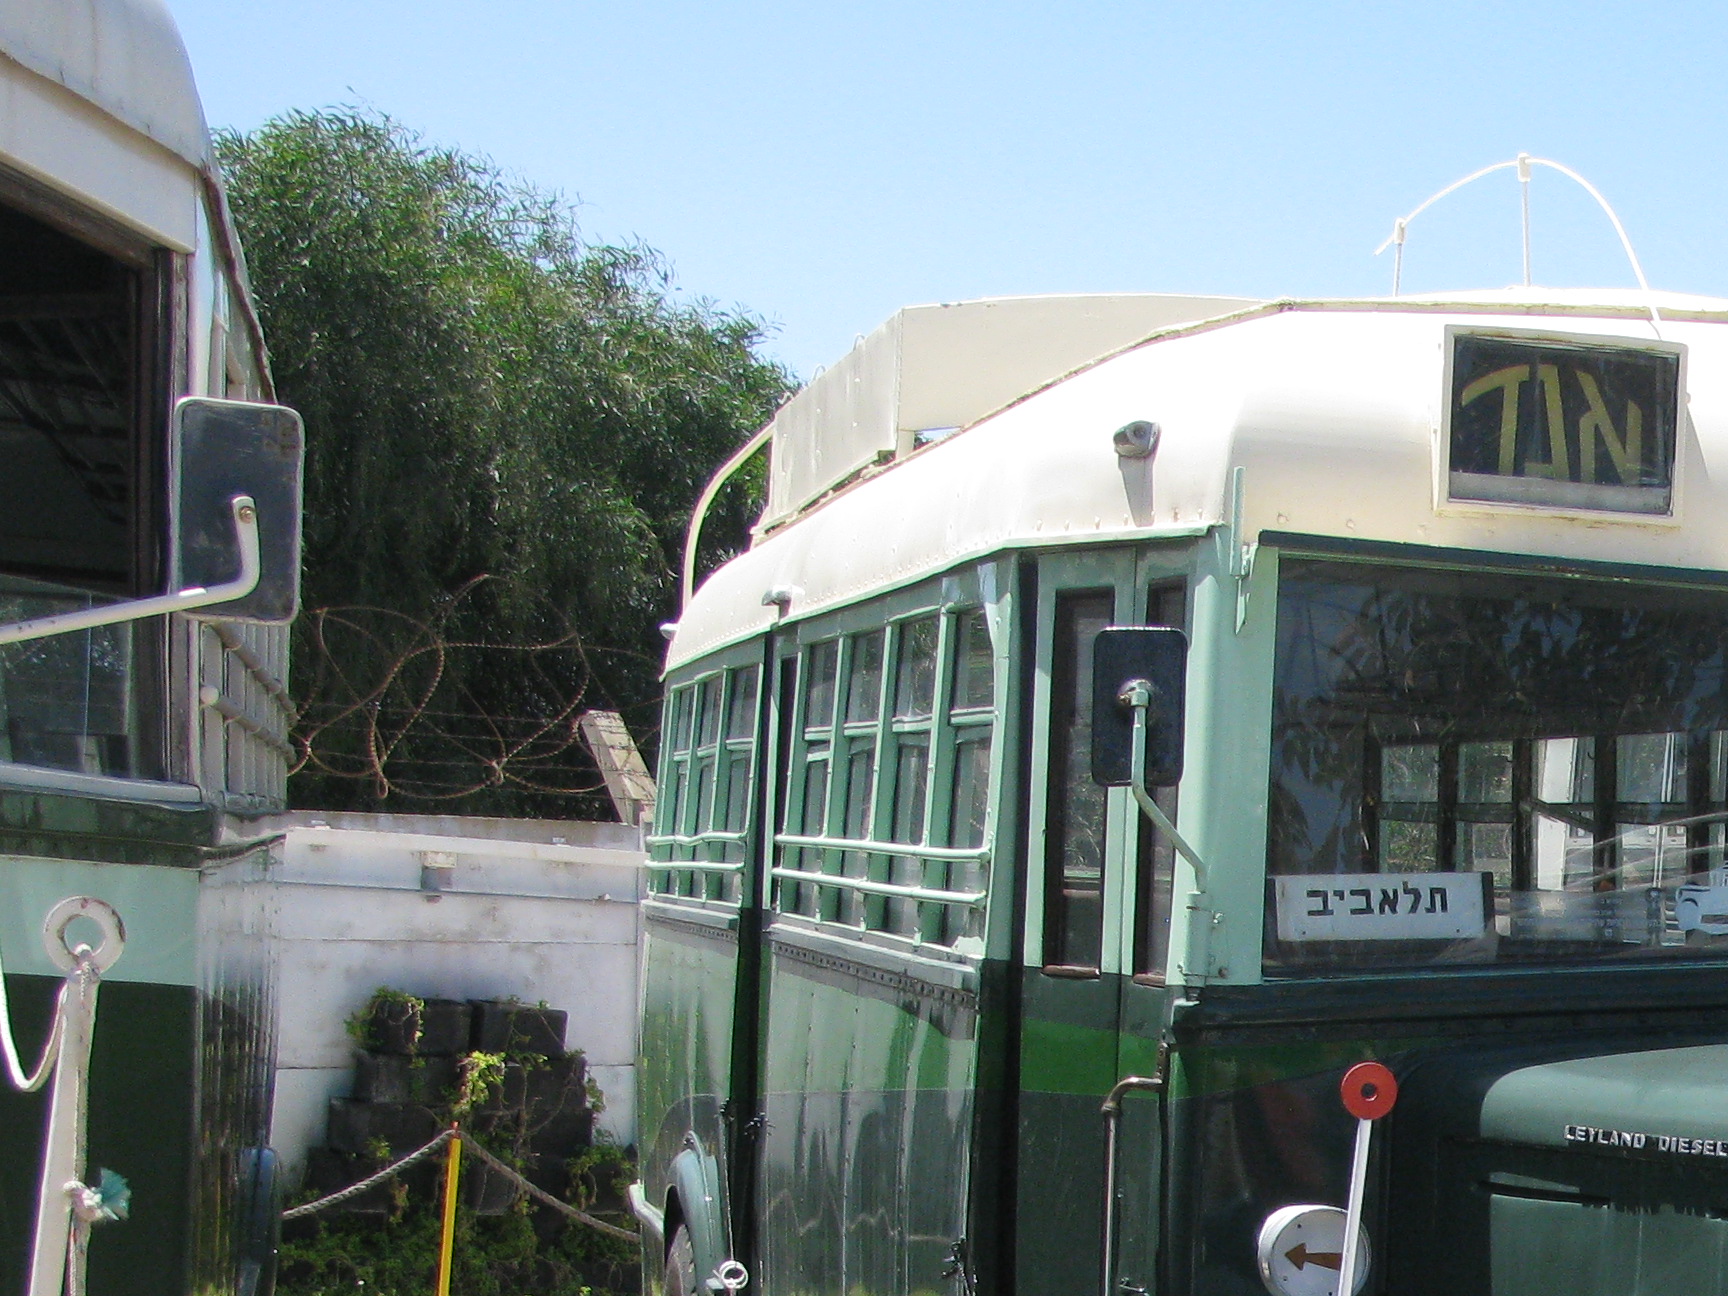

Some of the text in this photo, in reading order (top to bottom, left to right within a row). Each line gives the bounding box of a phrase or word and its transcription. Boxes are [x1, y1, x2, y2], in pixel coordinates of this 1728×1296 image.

[1462, 363, 1643, 487] אגד
[1306, 881, 1449, 917] תלאביב
[1564, 1124, 1645, 1149] LEYLAND
